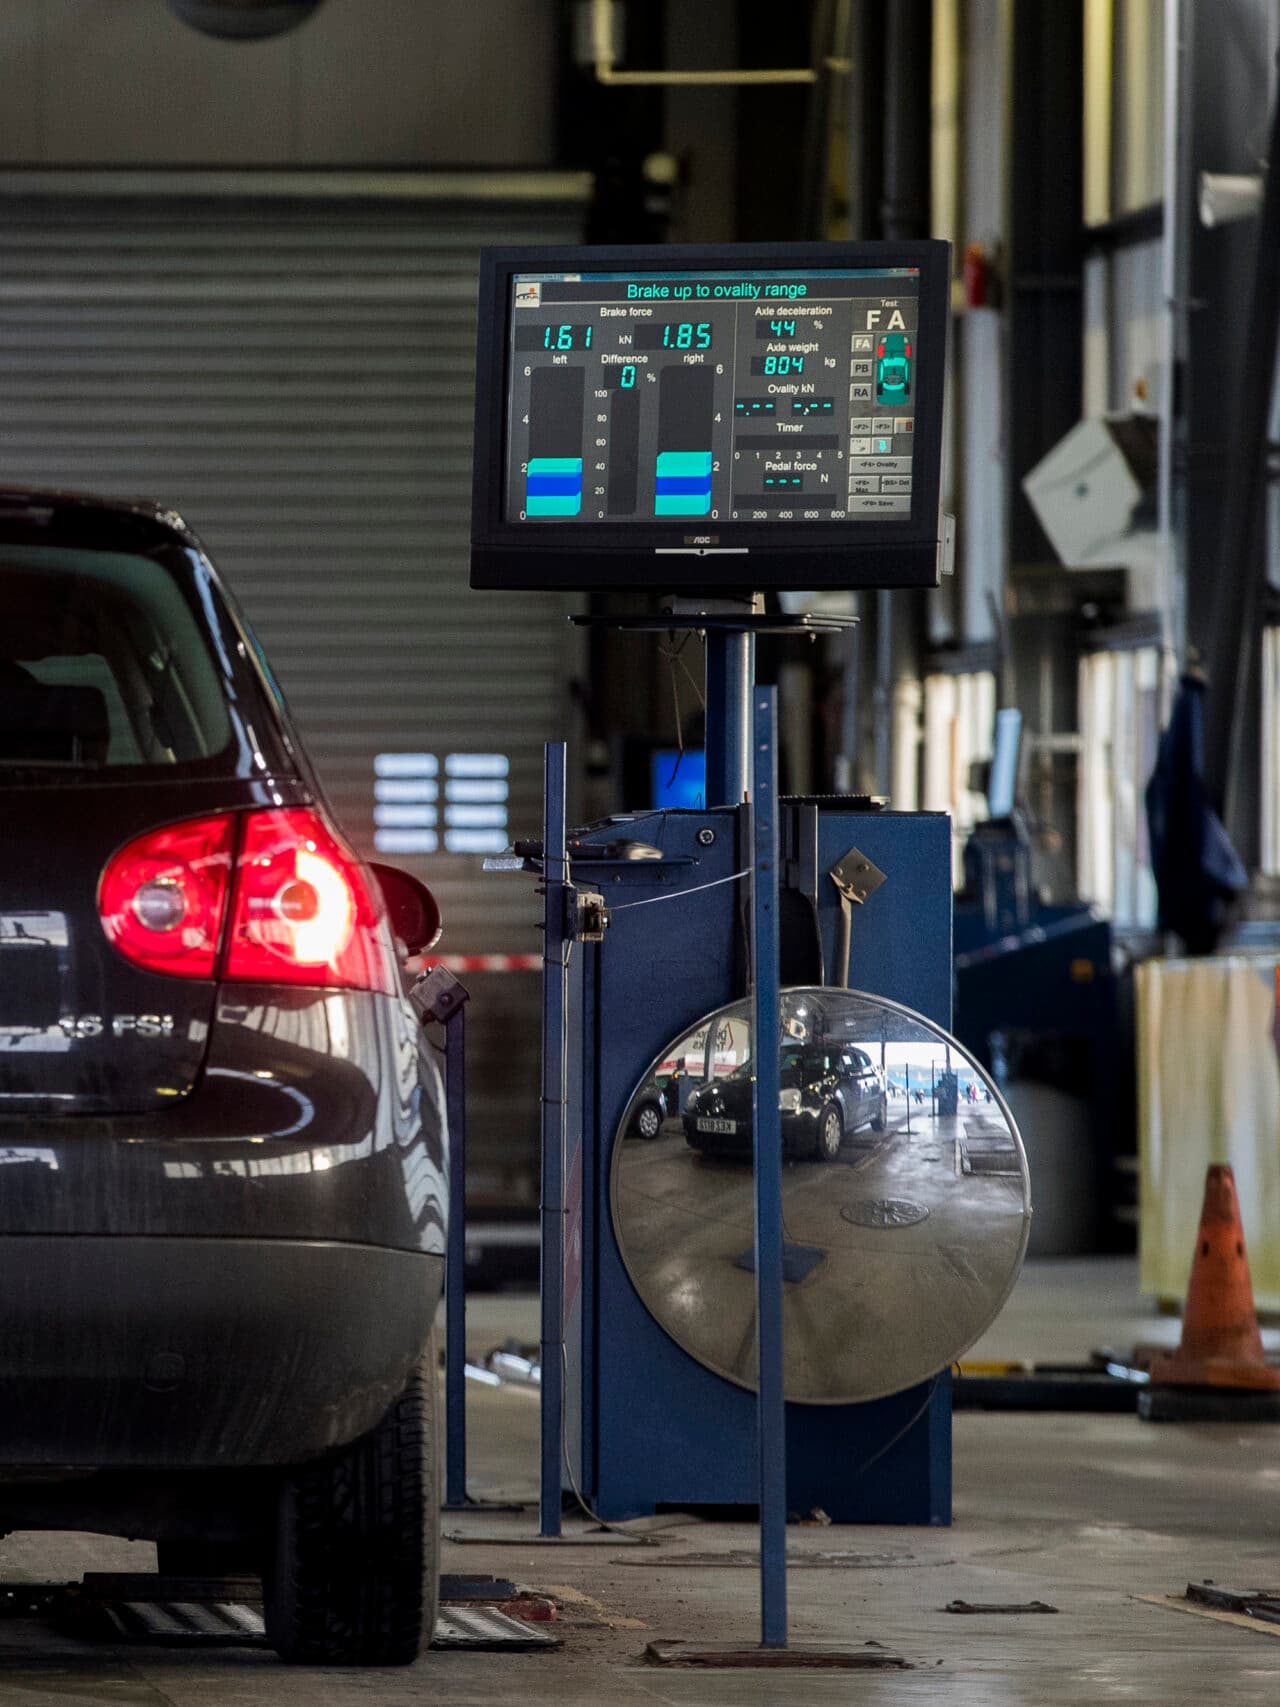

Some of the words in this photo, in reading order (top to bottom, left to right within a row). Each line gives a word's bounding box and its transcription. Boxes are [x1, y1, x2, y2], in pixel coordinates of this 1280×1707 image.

[627, 284, 670, 299] Brake
[674, 286, 692, 300] up
[696, 285, 710, 297] to
[714, 283, 761, 300] ovality
[765, 284, 807, 299] range
[880, 299, 898, 308] Test
[600, 307, 627, 317] Brake
[629, 307, 653, 317] force
[755, 307, 775, 316] Axle
[776, 306, 833, 316] deceleration
[770, 320, 796, 337] 44
[543, 325, 593, 350] 1.61
[618, 335, 632, 345] kN
[663, 323, 711, 349] 1.85
[766, 343, 787, 352] Axle
[789, 343, 819, 354] weight
[855, 339, 871, 349] FA
[552, 355, 568, 365] left
[601, 354, 648, 364] Difference
[683, 354, 705, 365] right
[715, 364, 724, 375] 6
[764, 356, 804, 375] 804
[824, 357, 837, 369] kg
[855, 364, 869, 373] PB
[524, 366, 532, 377] 6
[620, 365, 637, 388] 0
[594, 389, 608, 398] 100
[768, 384, 799, 395] Ovality
[801, 383, 815, 393] kN
[854, 388, 869, 397] RA
[522, 414, 529, 424] 4
[596, 414, 608, 423] 80
[714, 412, 722, 423] 4
[776, 422, 804, 432] Timer
[595, 438, 607, 447] 60
[521, 462, 528, 473] 2
[595, 462, 606, 471] 40
[713, 461, 720, 472] 2
[765, 461, 792, 471] Pedal
[793, 461, 818, 471] force
[820, 474, 829, 483] N
[594, 486, 605, 495] 20
[520, 510, 527, 520] 0
[598, 510, 605, 519] 0
[711, 510, 719, 520] 0
[732, 511, 738, 519] 0
[752, 510, 768, 519] 200
[778, 510, 793, 519] 400
[804, 510, 819, 519] 600
[831, 510, 845, 518] 800
